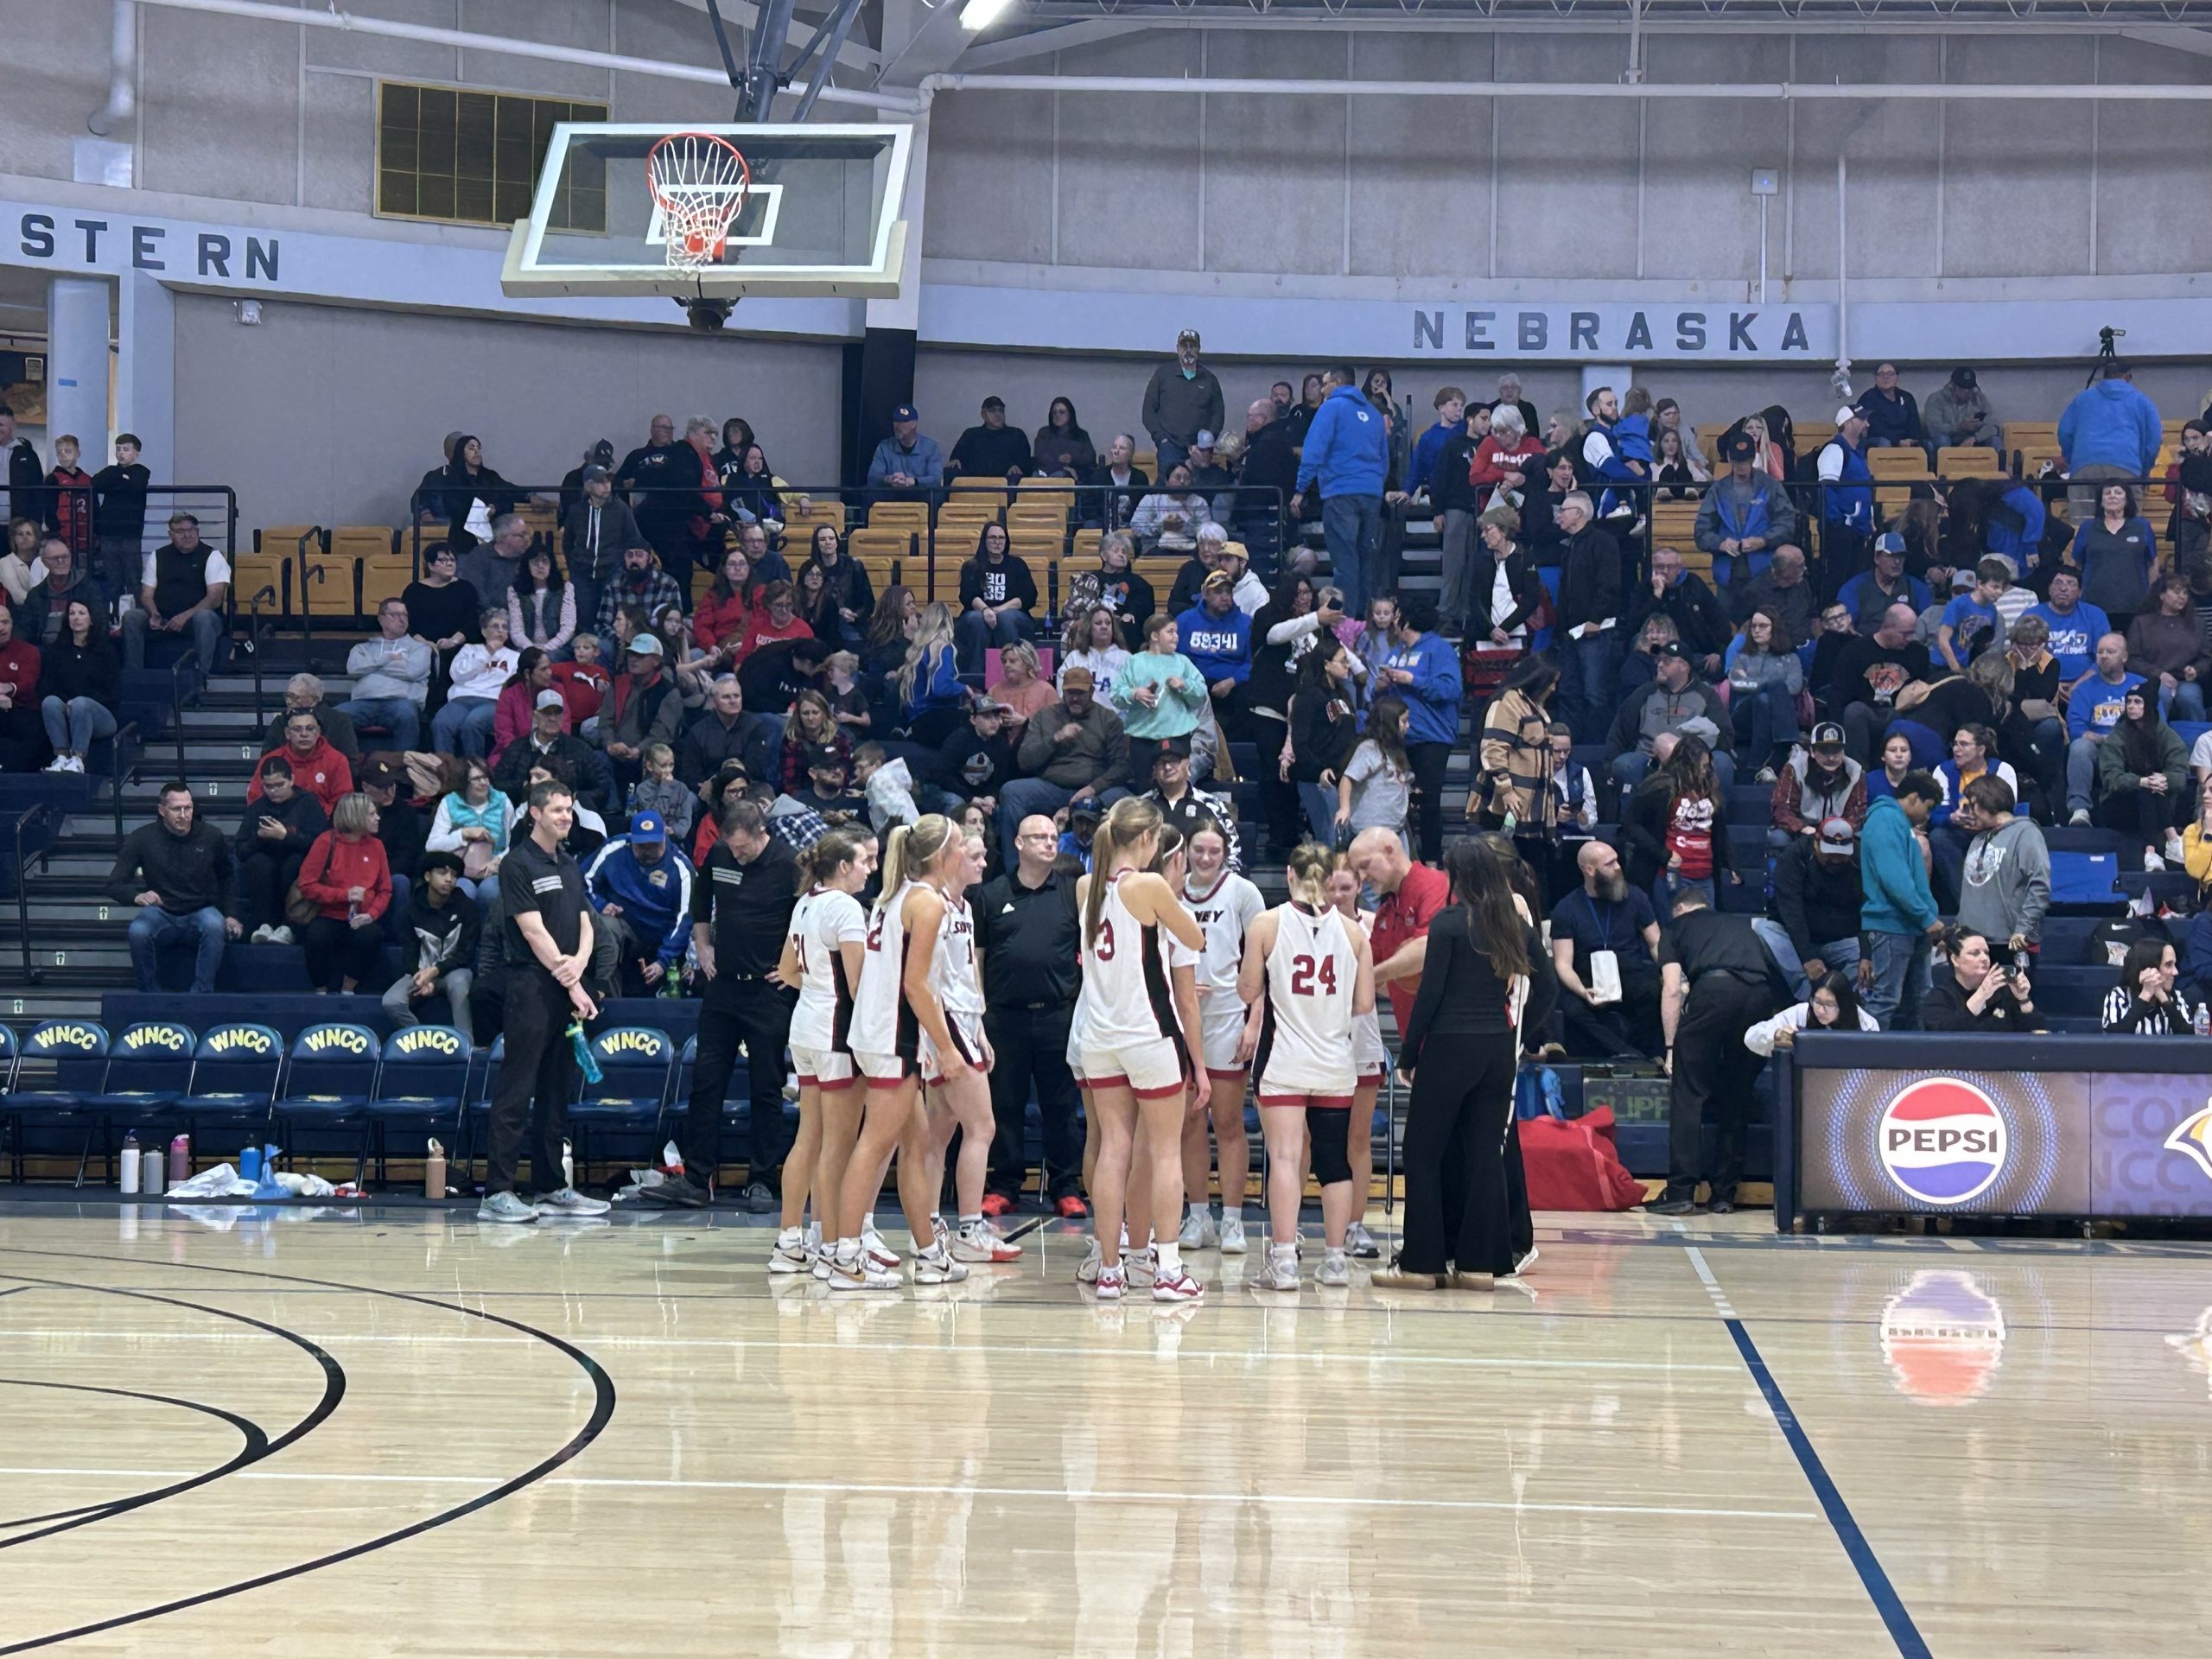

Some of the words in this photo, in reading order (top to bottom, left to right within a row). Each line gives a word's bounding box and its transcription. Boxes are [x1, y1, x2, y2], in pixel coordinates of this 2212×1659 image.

[1413, 310, 1810, 351] NEBRASKA
[1292, 954, 1337, 997] 24
[35, 1026, 97, 1050] WNCC
[124, 1027, 184, 1050] WNCC
[208, 1028, 270, 1053] WNCC
[305, 1028, 367, 1054] WNCC
[397, 1030, 460, 1055] WNCC
[601, 1031, 661, 1056] WNCC
[1888, 1128, 1997, 1153] PEPSI
